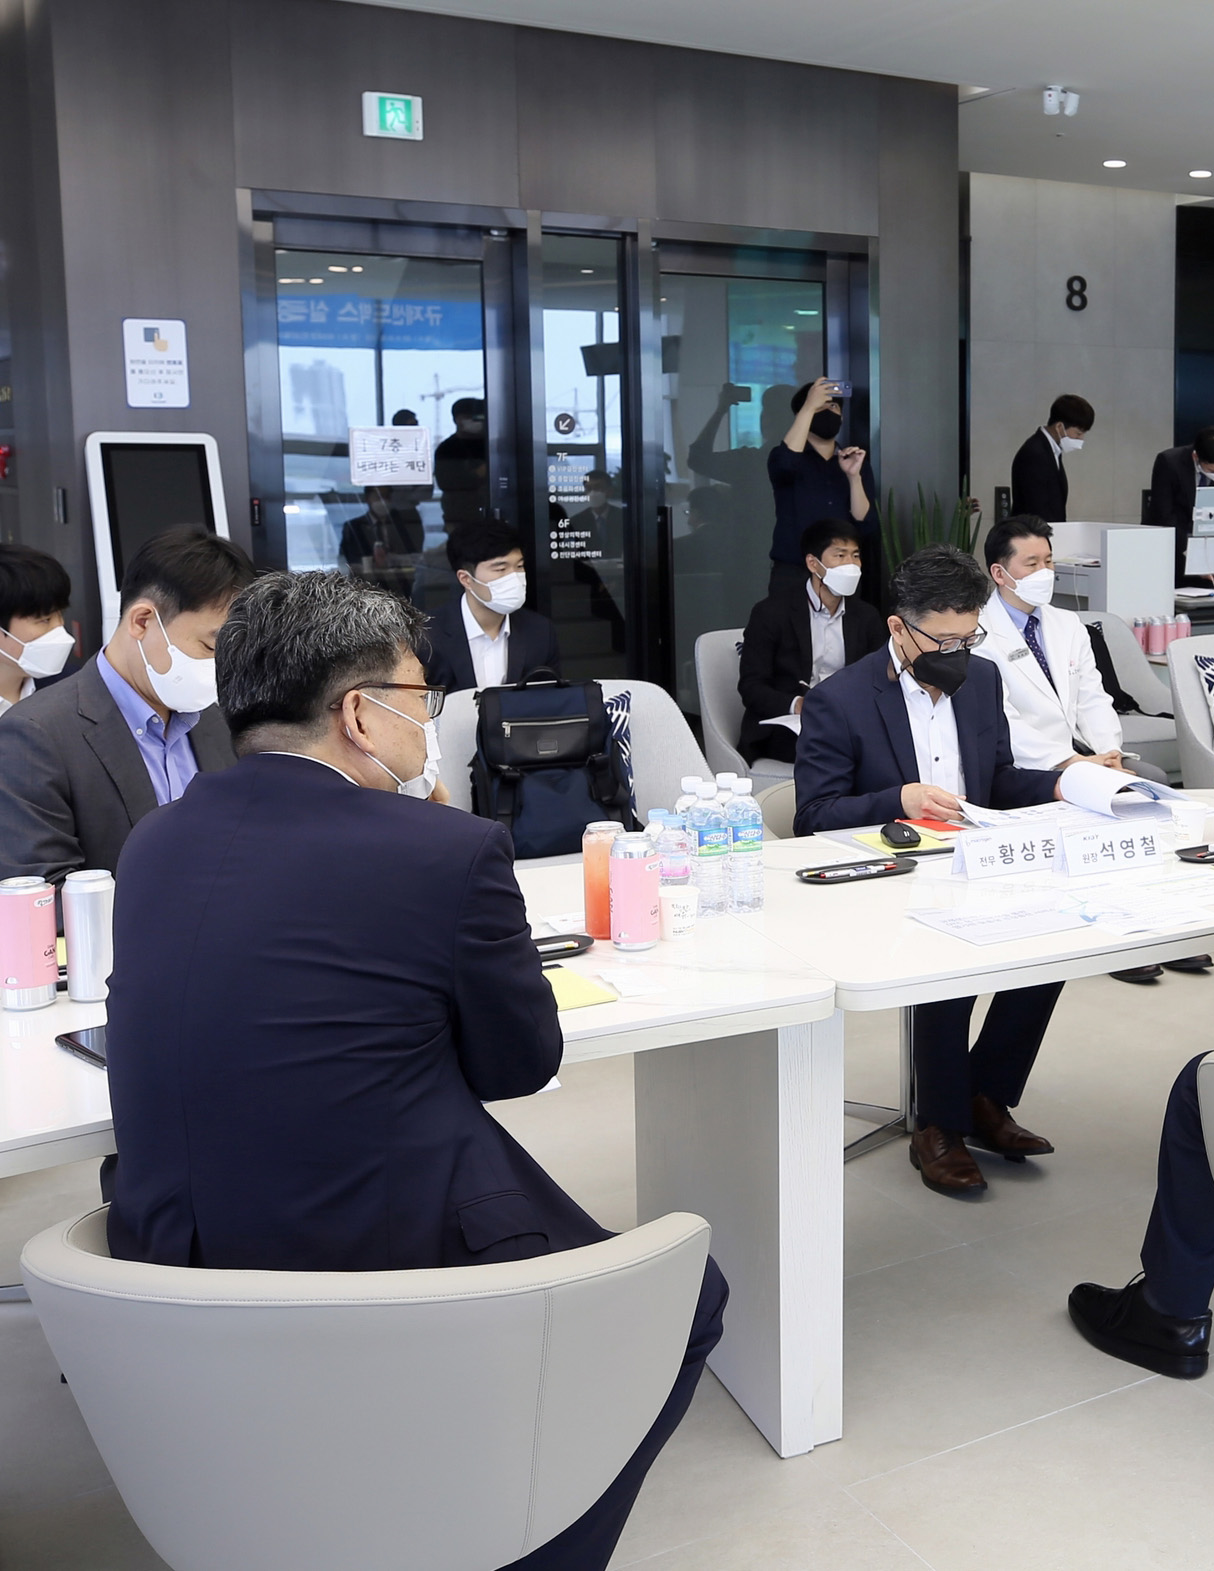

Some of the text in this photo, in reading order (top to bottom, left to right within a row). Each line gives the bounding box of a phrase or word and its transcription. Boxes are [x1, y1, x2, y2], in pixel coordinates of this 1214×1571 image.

[1066, 275, 1088, 311] 8
[405, 460, 426, 473] 계단
[556, 452, 568, 461] 7F
[558, 519, 570, 528] 6F
[979, 838, 1056, 867] 전무 황상준
[1082, 835, 1157, 864] 원장 석영철
